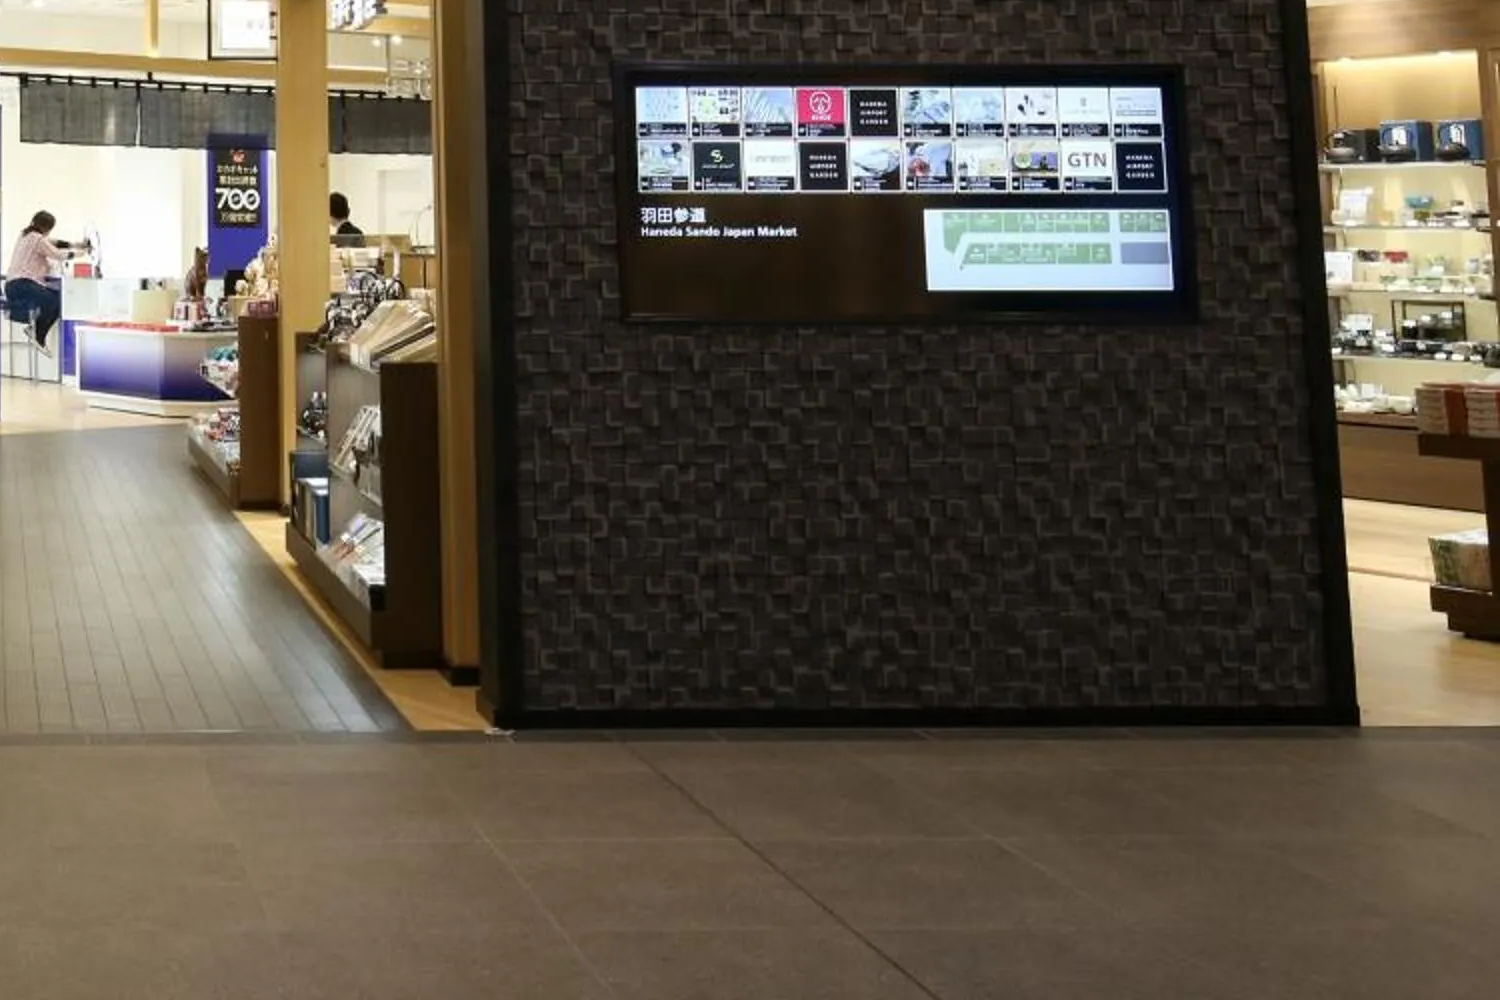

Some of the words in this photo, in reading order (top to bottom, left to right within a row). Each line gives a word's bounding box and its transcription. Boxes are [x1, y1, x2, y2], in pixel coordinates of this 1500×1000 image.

[1067, 152, 1107, 168] GTN
[215, 188, 260, 210] 700
[641, 226, 683, 237] Haneda
[685, 226, 720, 237] Sando
[723, 226, 755, 239] Japan
[757, 226, 798, 237] Market
